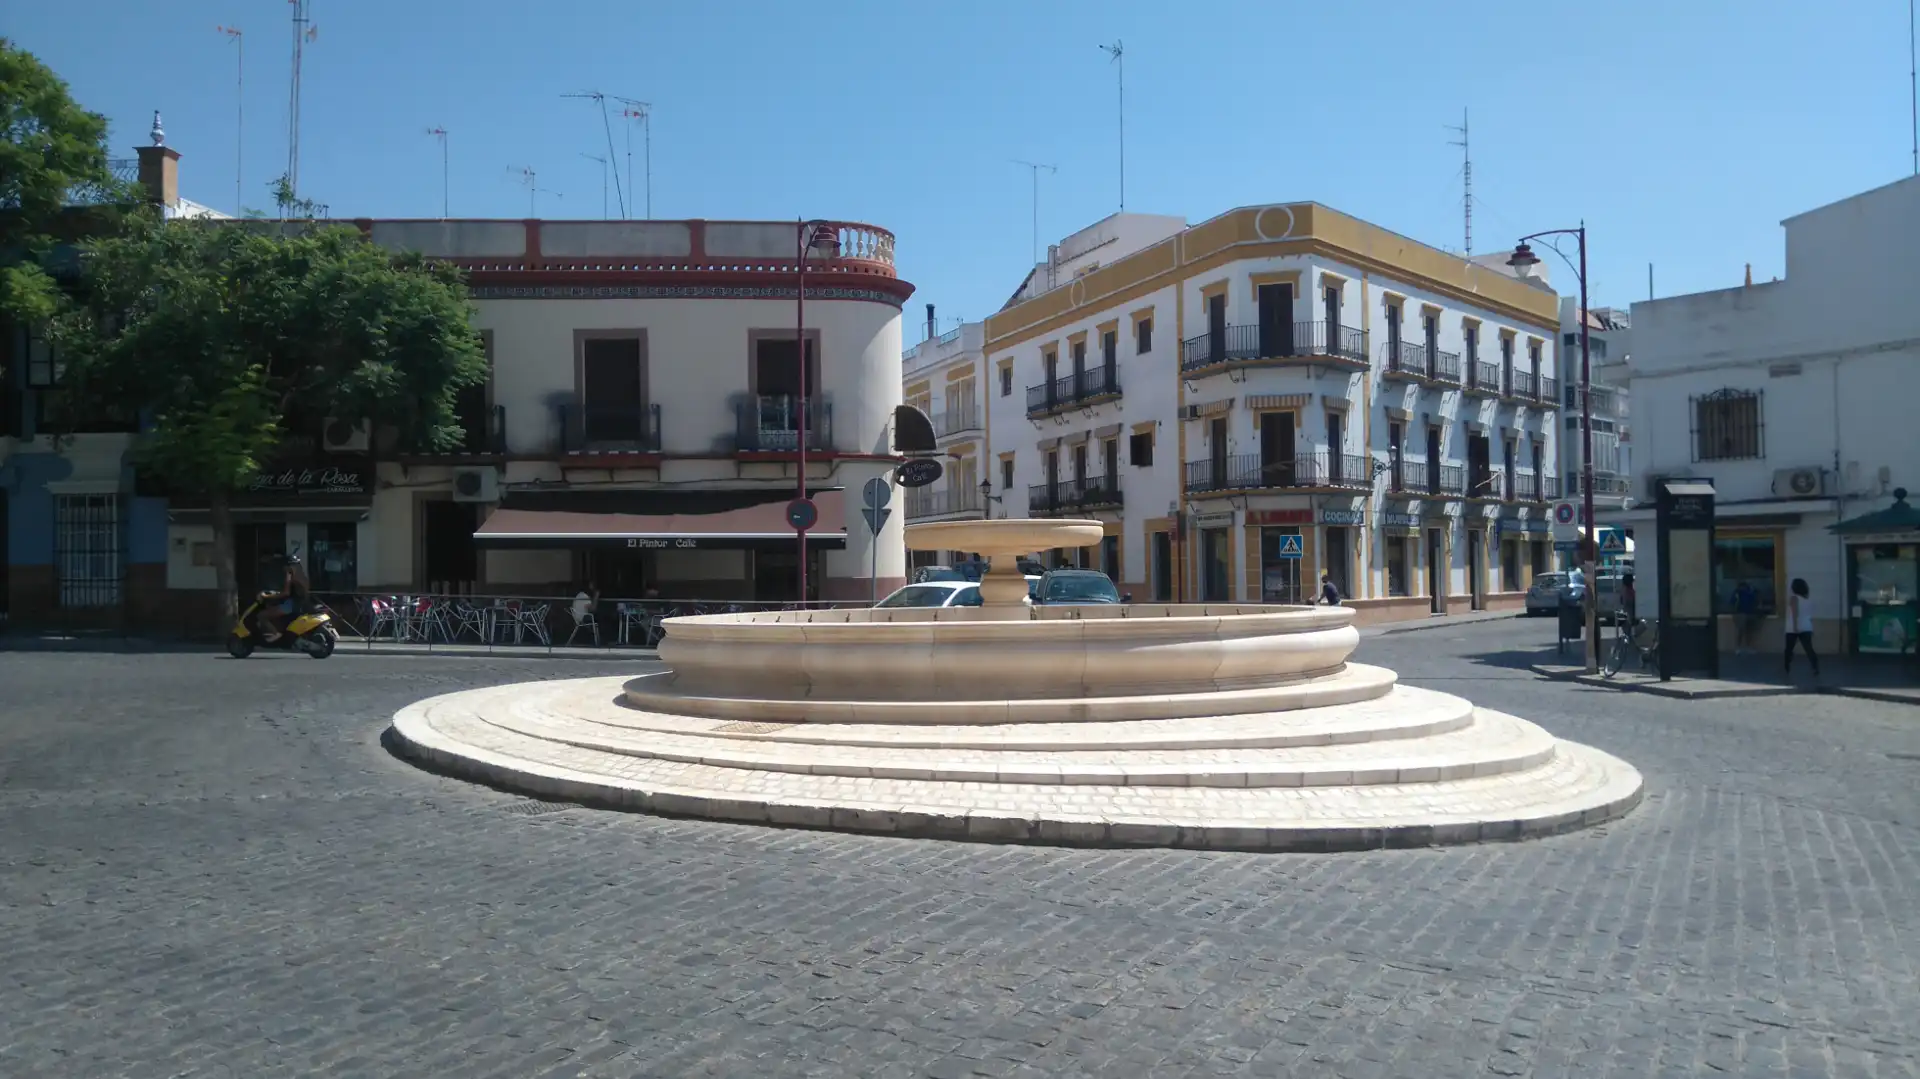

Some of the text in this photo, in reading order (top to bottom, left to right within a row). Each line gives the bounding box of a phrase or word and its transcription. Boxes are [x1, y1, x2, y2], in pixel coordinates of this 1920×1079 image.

[277, 469, 295, 485] de
[298, 468, 313, 485] la
[320, 467, 360, 486] Rosa
[627, 539, 637, 548] El
[639, 539, 668, 548] Pintor
